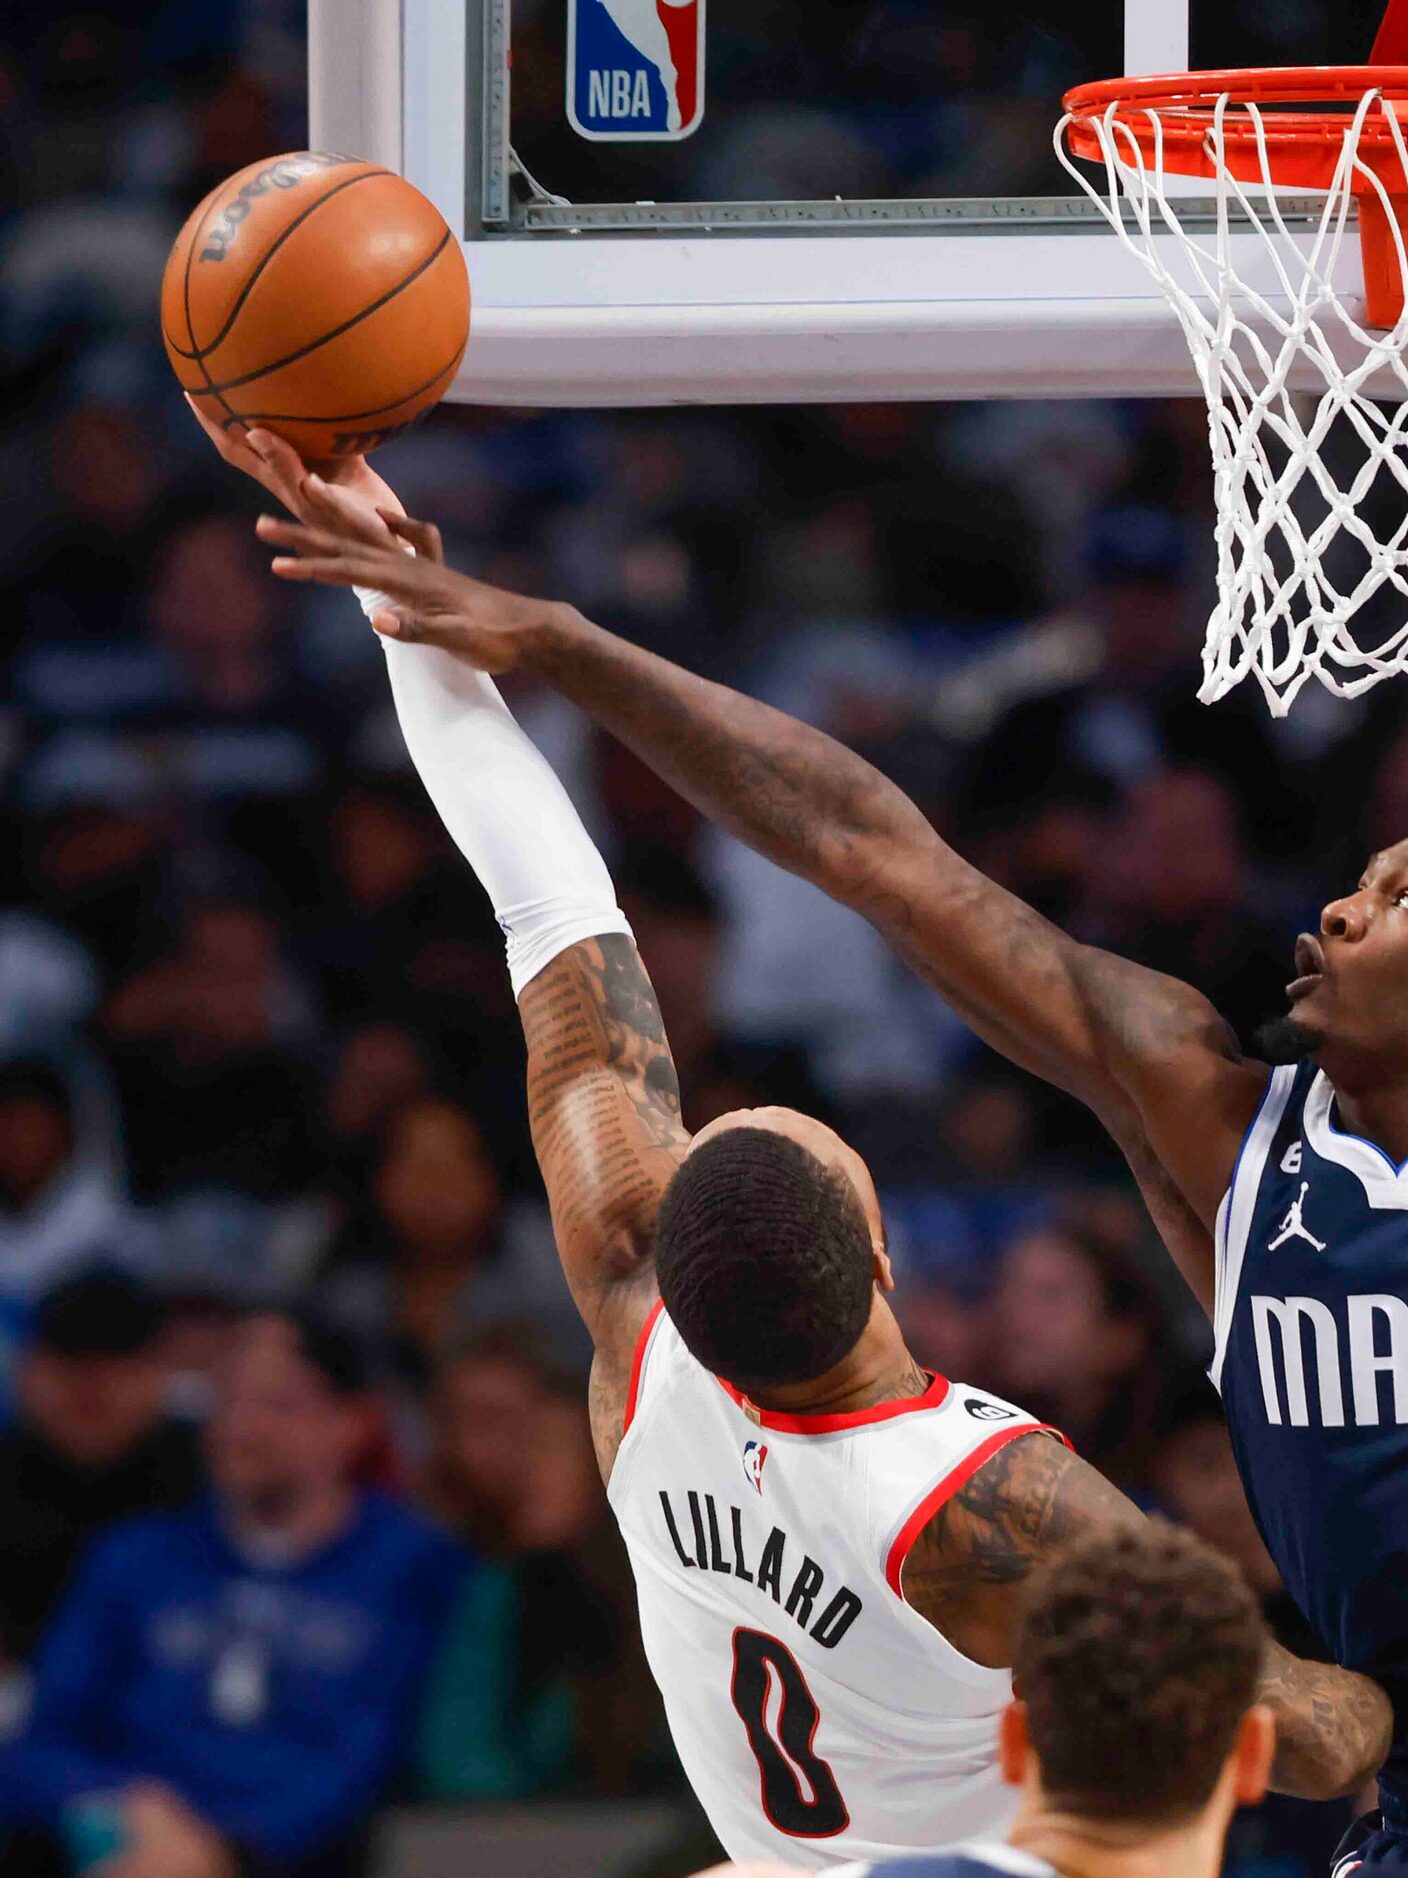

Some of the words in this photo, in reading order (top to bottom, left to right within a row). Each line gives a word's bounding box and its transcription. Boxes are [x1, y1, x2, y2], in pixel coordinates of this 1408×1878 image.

[588, 69, 651, 118] NBA
[658, 1490, 863, 1649] LILLARD
[730, 1626, 850, 1839] 0
